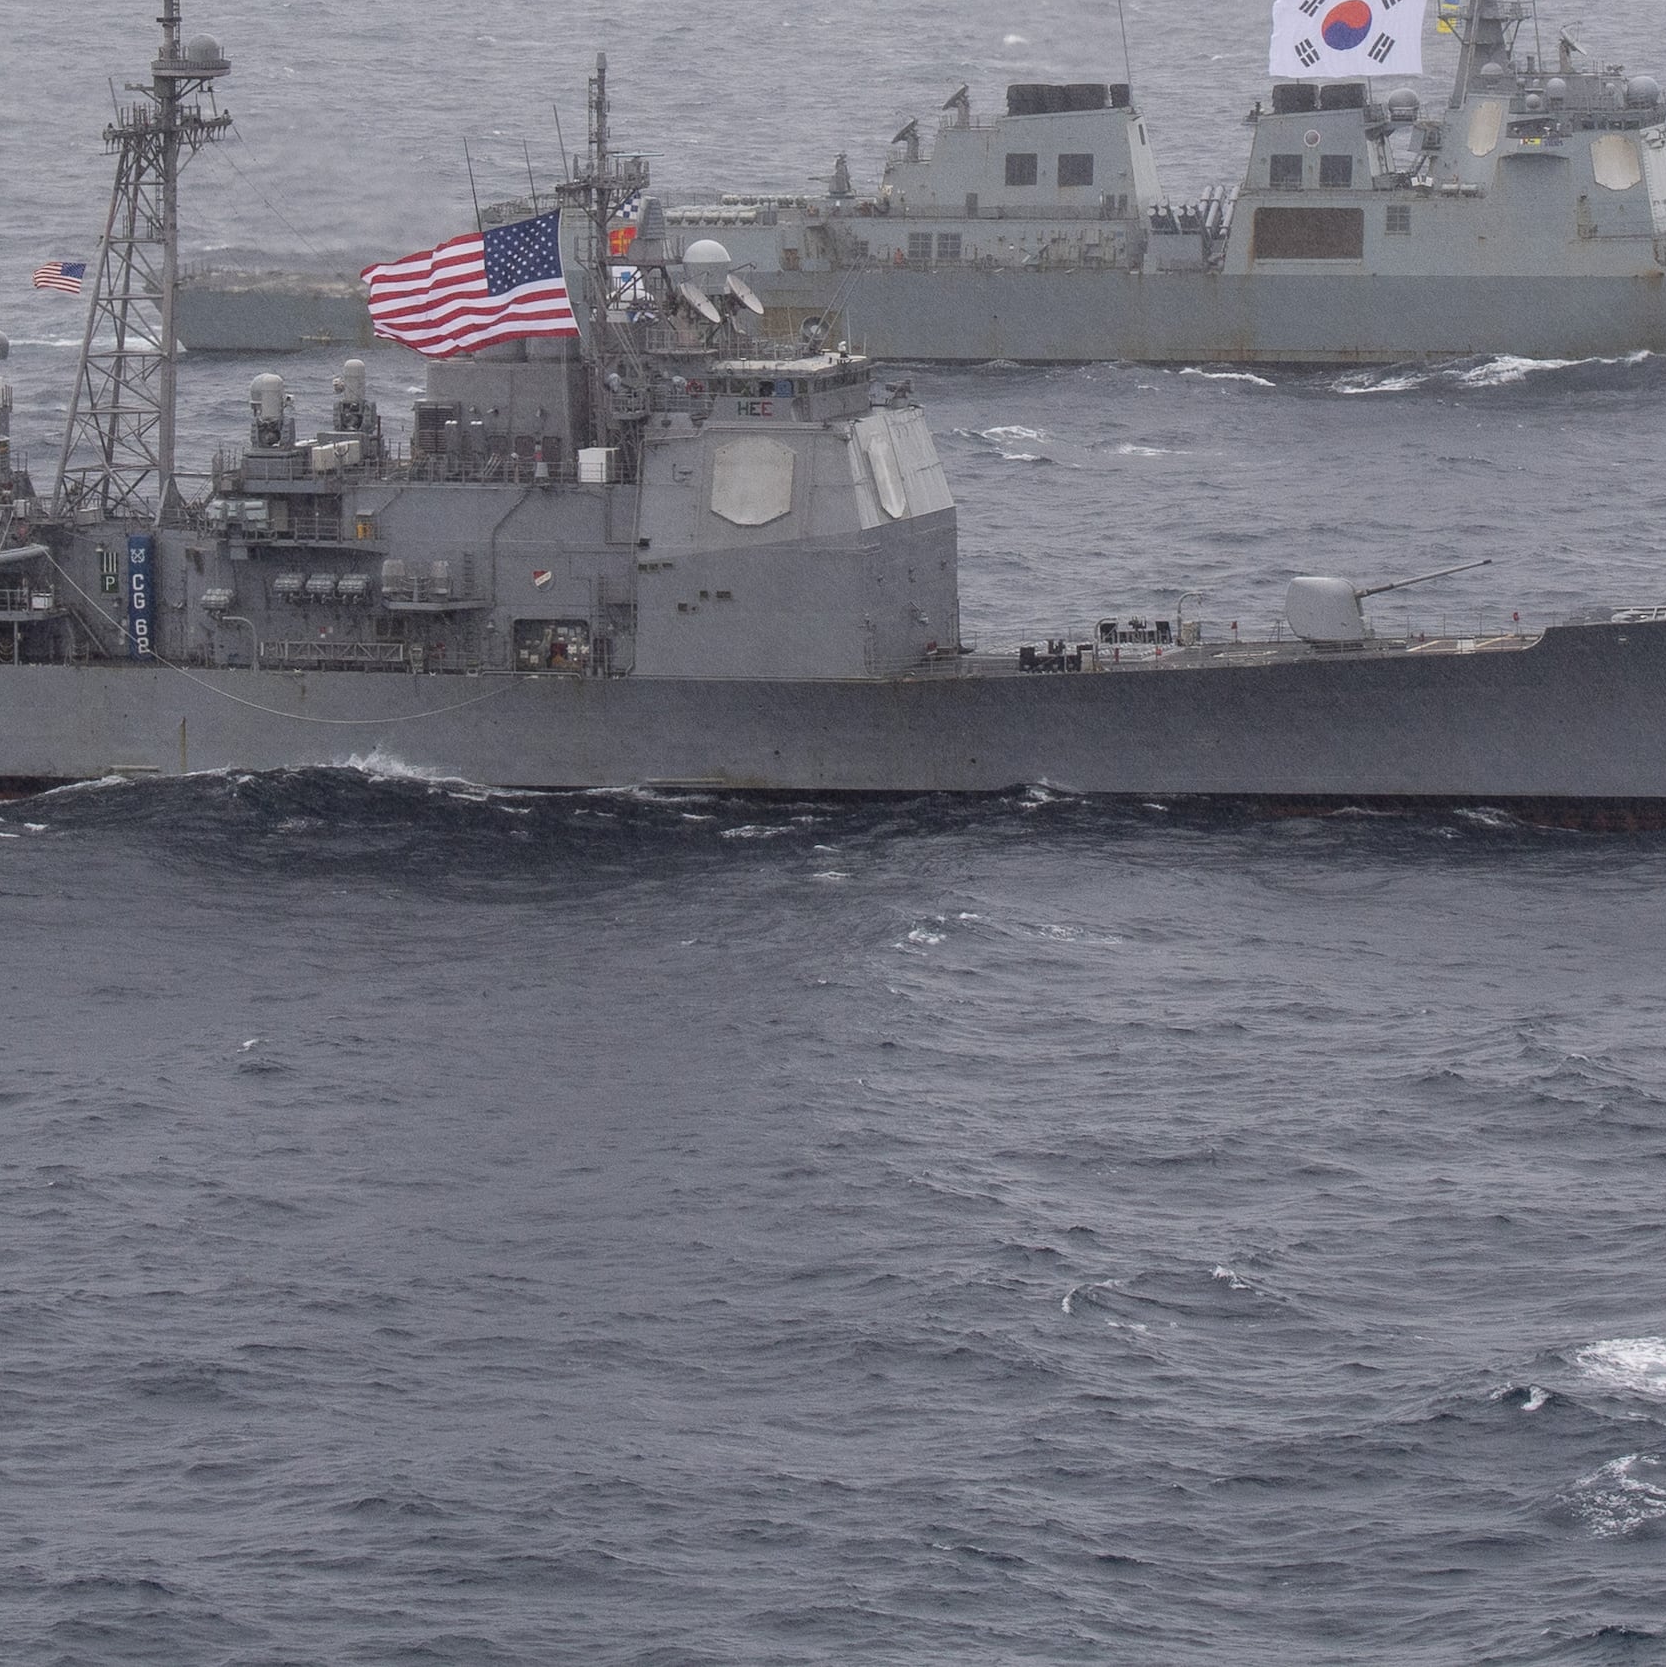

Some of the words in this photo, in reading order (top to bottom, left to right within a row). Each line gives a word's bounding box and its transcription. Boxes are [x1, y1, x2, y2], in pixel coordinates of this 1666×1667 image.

[737, 401, 773, 416] HEE
[105, 576, 115, 590] P
[132, 573, 145, 609] CG
[135, 619, 149, 654] 62
